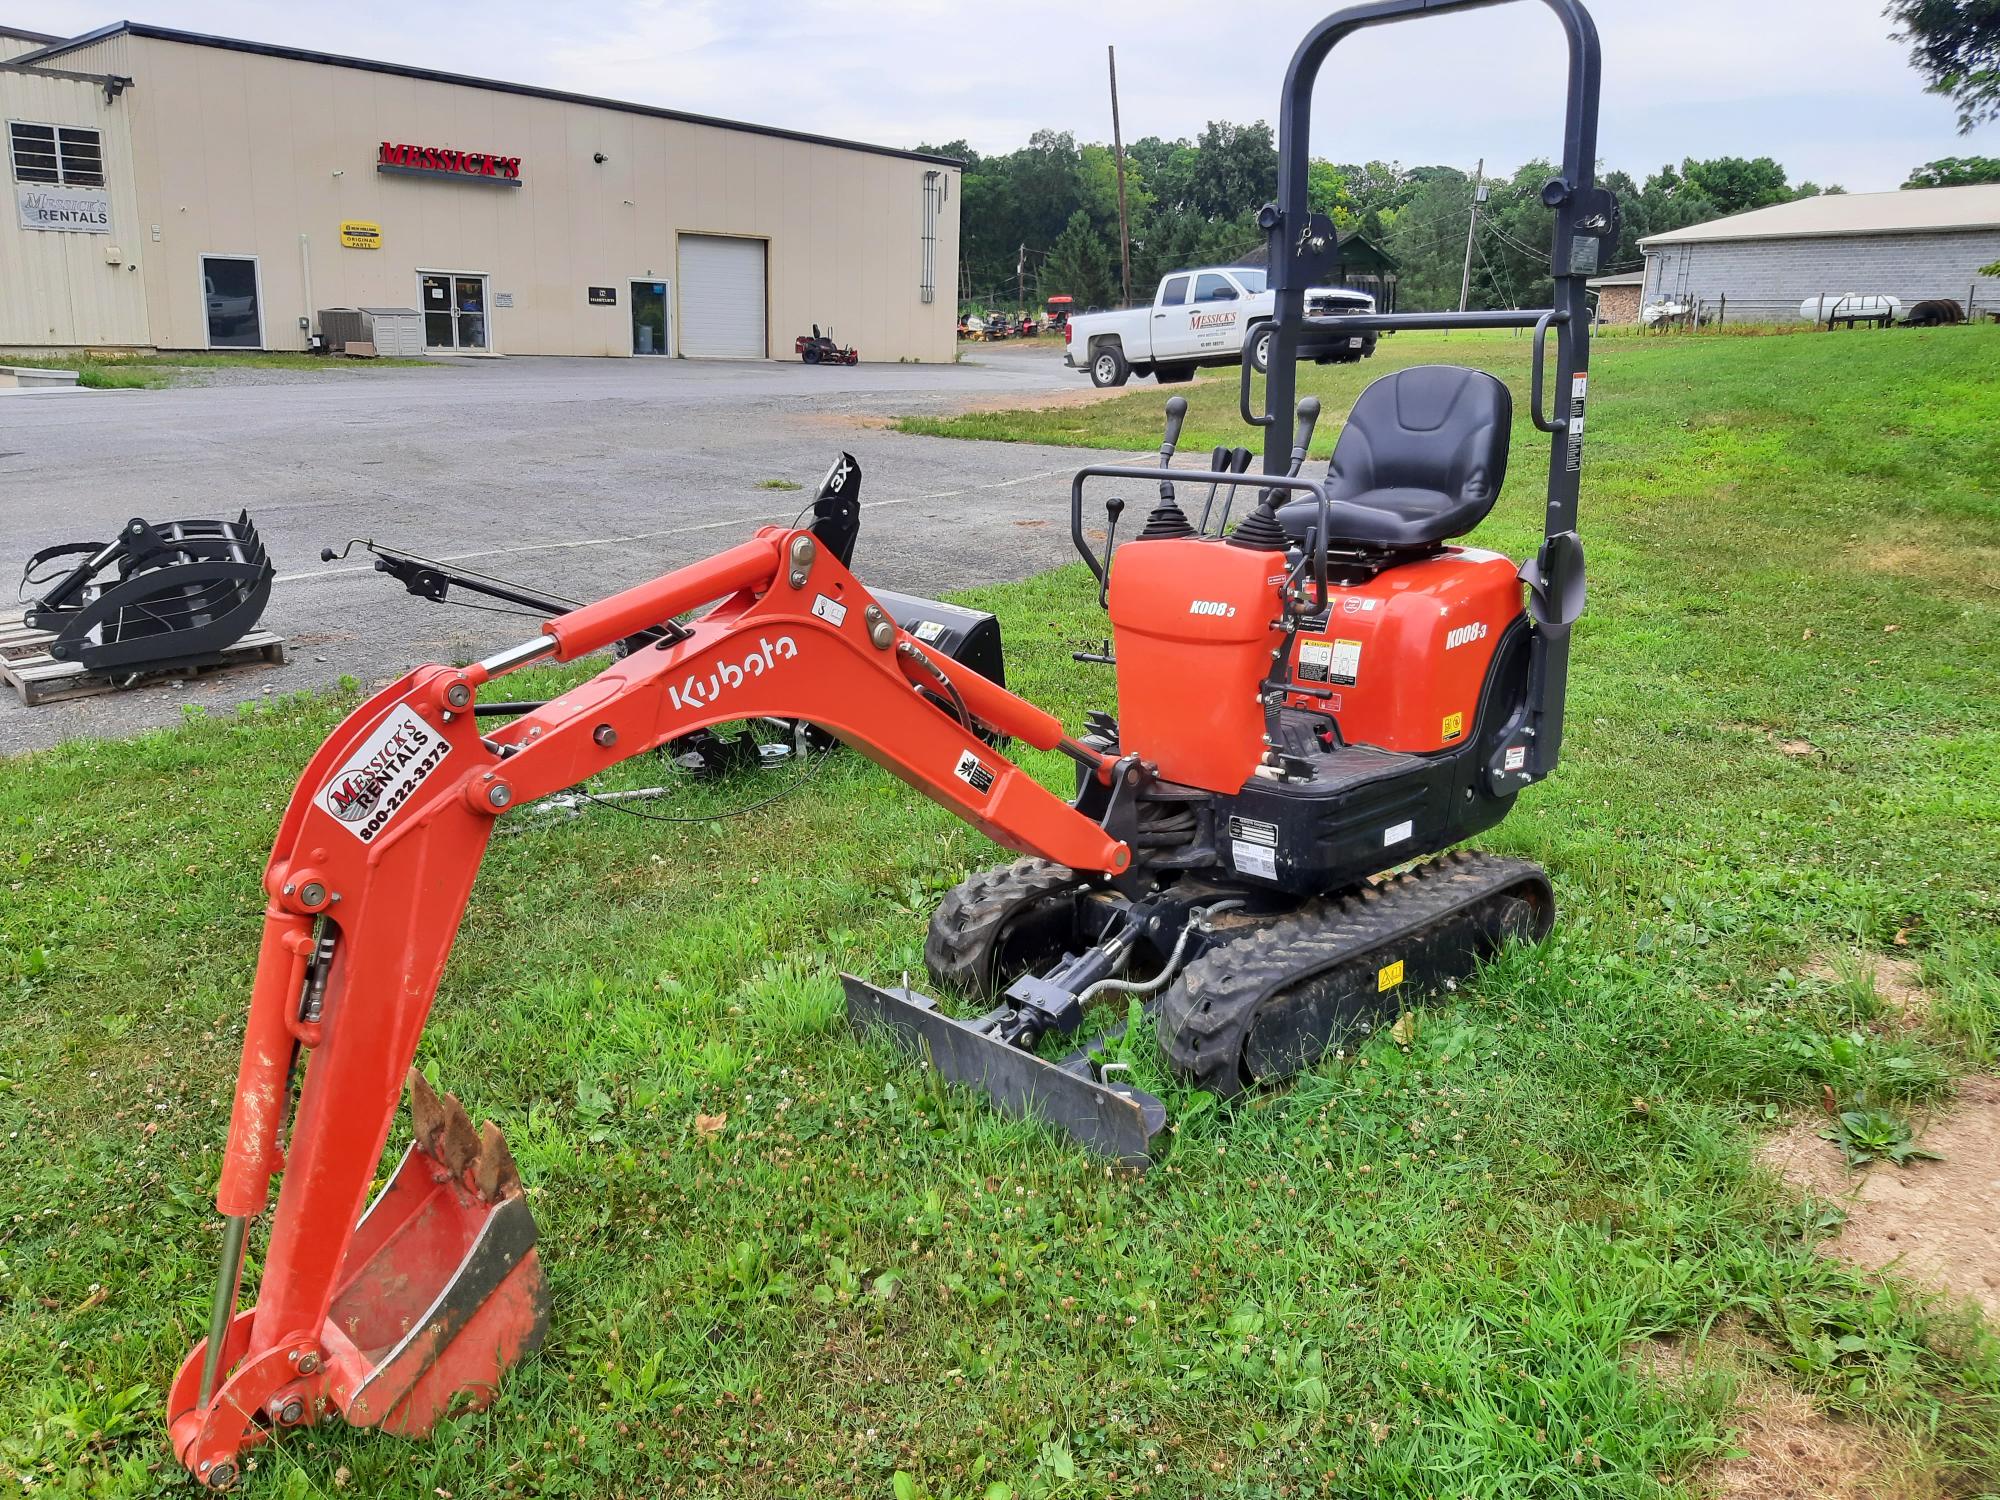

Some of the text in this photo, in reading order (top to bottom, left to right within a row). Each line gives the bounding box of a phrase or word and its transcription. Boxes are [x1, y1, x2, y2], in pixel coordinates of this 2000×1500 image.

[377, 141, 521, 178] MESSICK'S
[25, 192, 106, 213] MESSICK'S
[39, 210, 107, 224] RENTALS
[1189, 312, 1237, 330] MESSICK'S
[1445, 621, 1487, 650] K008-3
[668, 636, 798, 710] Kubota
[330, 719, 417, 814] MESSICK'S
[356, 731, 429, 810] RENTALS
[359, 741, 450, 841] 800-222-3373
